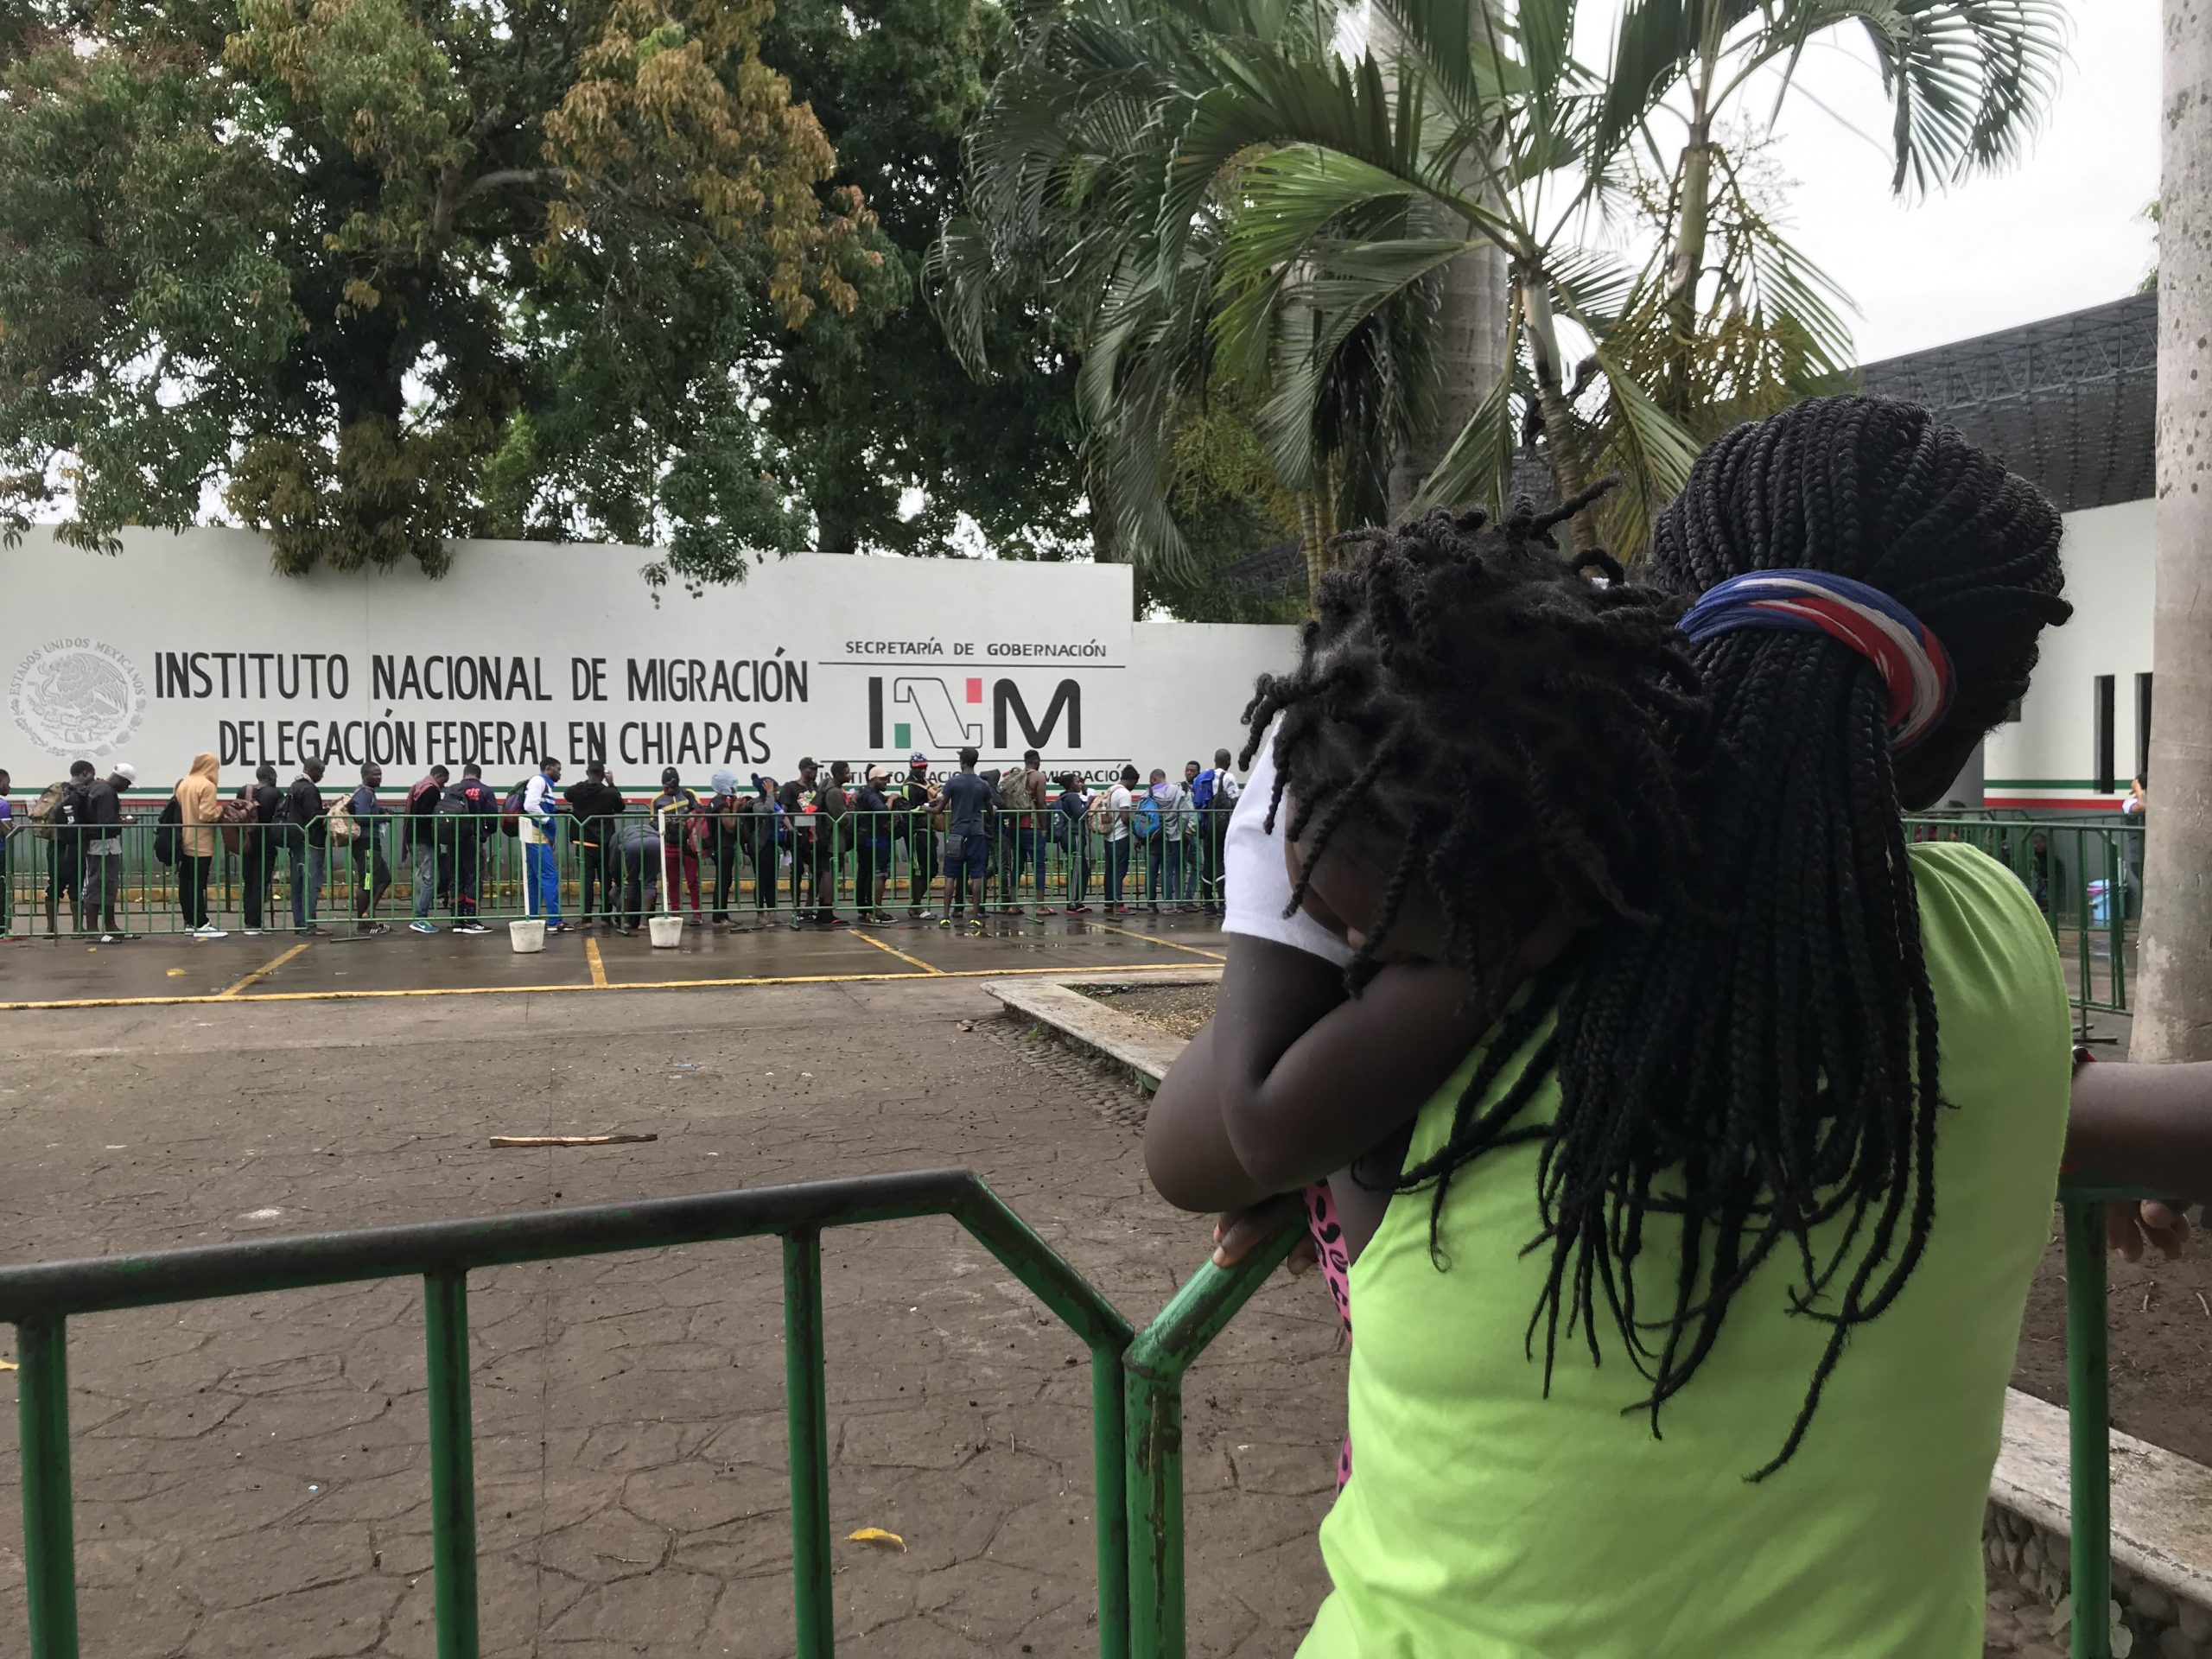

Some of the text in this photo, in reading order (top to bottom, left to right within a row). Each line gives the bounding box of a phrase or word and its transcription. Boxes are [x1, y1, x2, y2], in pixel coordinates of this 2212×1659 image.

[10, 638, 146, 696] ESTADOS UNIDOS MEXICANOS
[156, 646, 808, 702] INSTITUTO NACIONAL DE MIGRACIÓN
[846, 636, 1106, 657] SECRETARÍA DE GOBERNACIÓN
[219, 708, 771, 766] DELEGACIÓN FEDERAL EN CHIAPAS
